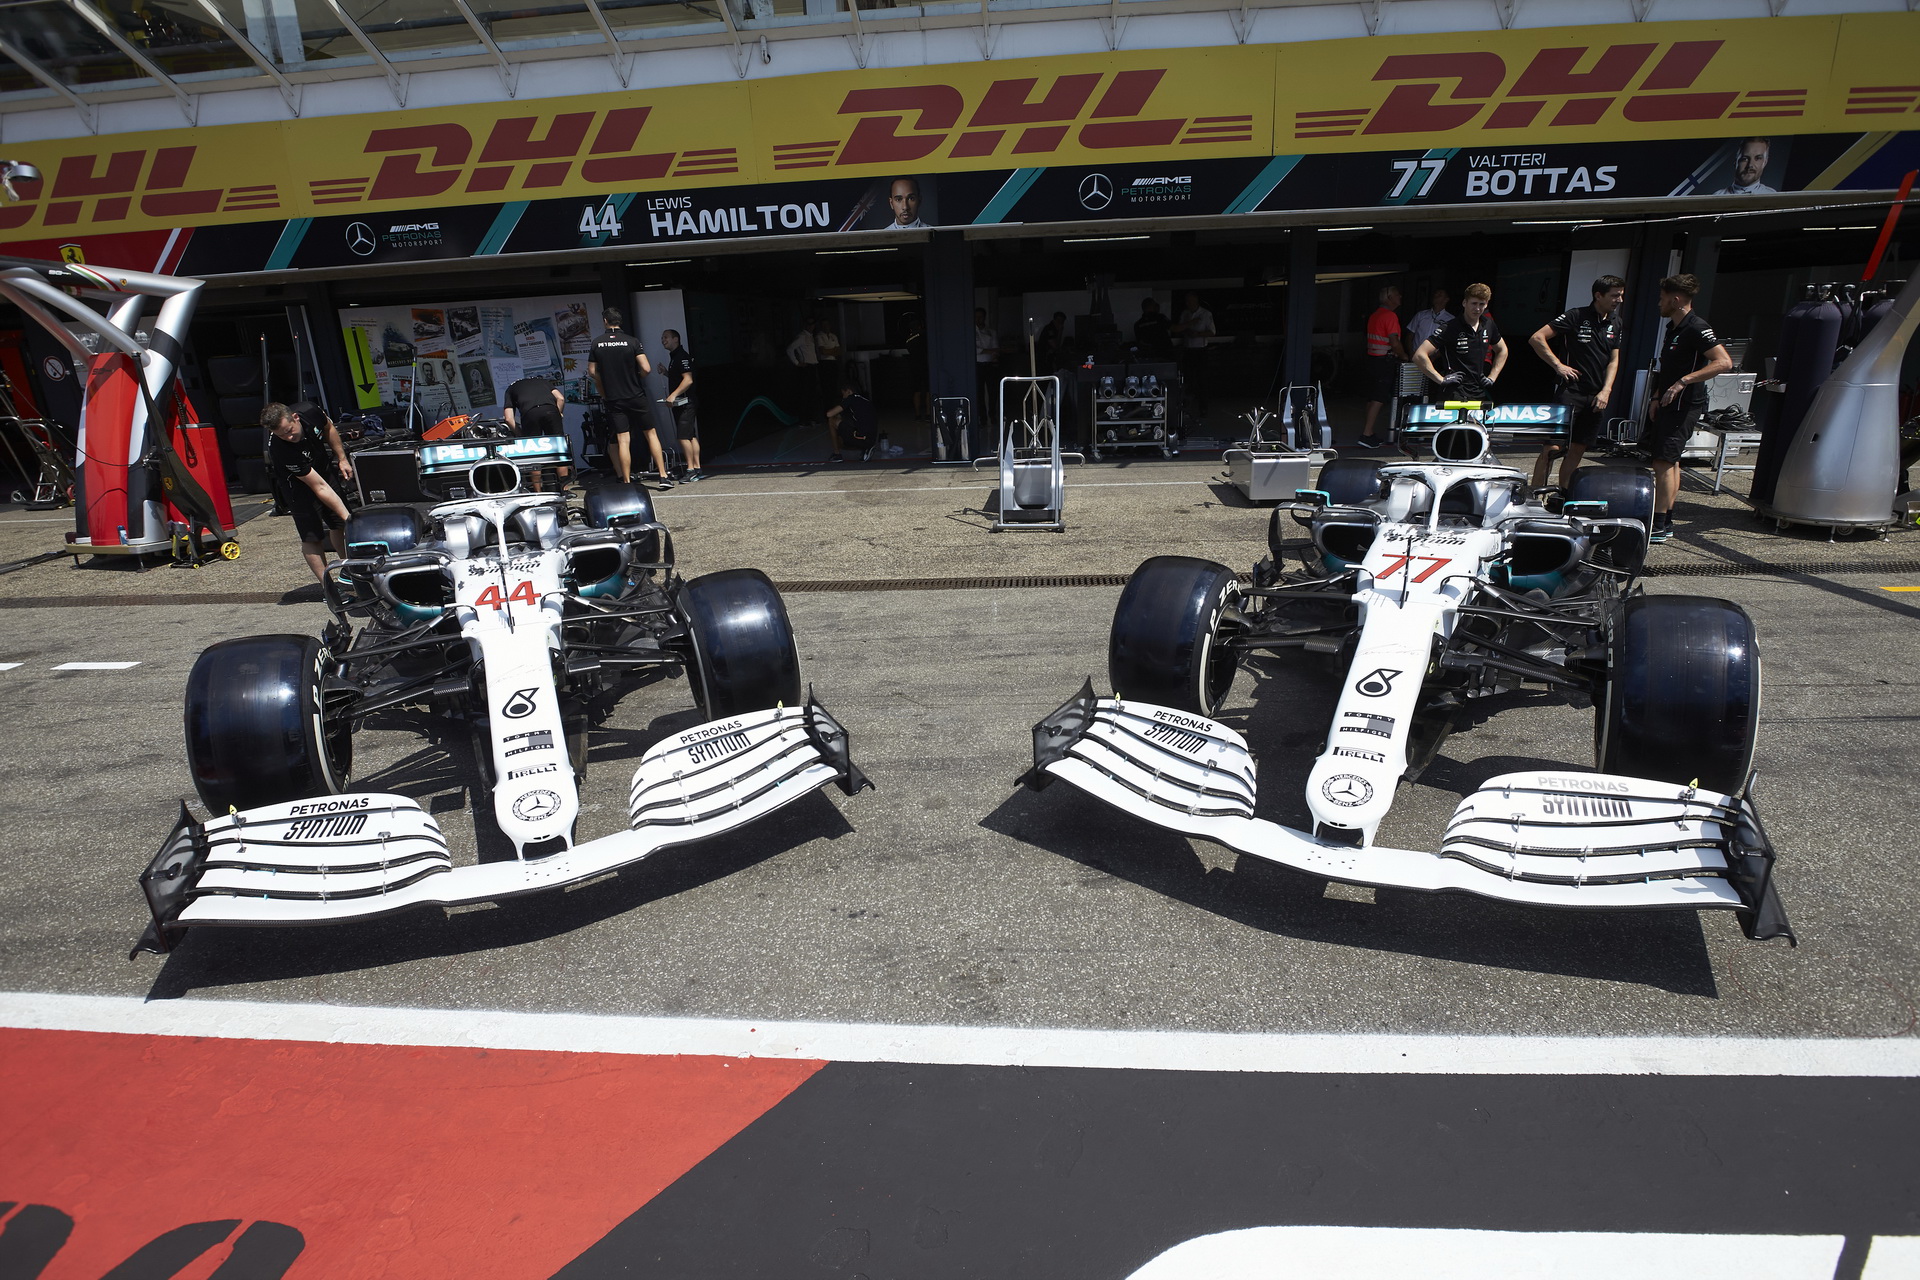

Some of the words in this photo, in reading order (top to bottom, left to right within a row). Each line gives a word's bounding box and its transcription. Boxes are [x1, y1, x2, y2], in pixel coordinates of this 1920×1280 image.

[1361, 40, 1740, 135] DHL
[836, 69, 1187, 165] DHL
[364, 106, 676, 200] DHL
[1469, 153, 1546, 168] VALTTERI
[1389, 159, 1447, 197] 77
[1466, 165, 1617, 197] BOTTAS
[1121, 185, 1192, 195] PETRONAS
[1131, 194, 1191, 203] MOTORSPORT
[647, 196, 692, 211] LEWIS
[579, 204, 622, 238] 44
[650, 202, 830, 237] HAMILTON
[381, 231, 441, 242] PETRONAS
[391, 239, 443, 248] MOTORSPORT
[1372, 553, 1453, 583] 77
[474, 580, 542, 611] 44
[1153, 710, 1213, 732] PETRONAS
[1347, 712, 1392, 721] TOMMY
[505, 730, 551, 741] TOMMY
[680, 720, 742, 744] PETRONAS
[1144, 723, 1208, 754] SYNTIUM
[1342, 727, 1390, 738] HILFIGER
[507, 744, 552, 755] HILFIGER
[688, 732, 751, 765] SYNTIUM
[1332, 746, 1386, 764] PIRELLI
[507, 763, 557, 781] PIRELLI
[1537, 776, 1629, 793] PETRONAS
[290, 798, 369, 816] PETRONAS
[1542, 792, 1633, 818] SYNTIUM
[282, 813, 368, 840] SYNTIUM
